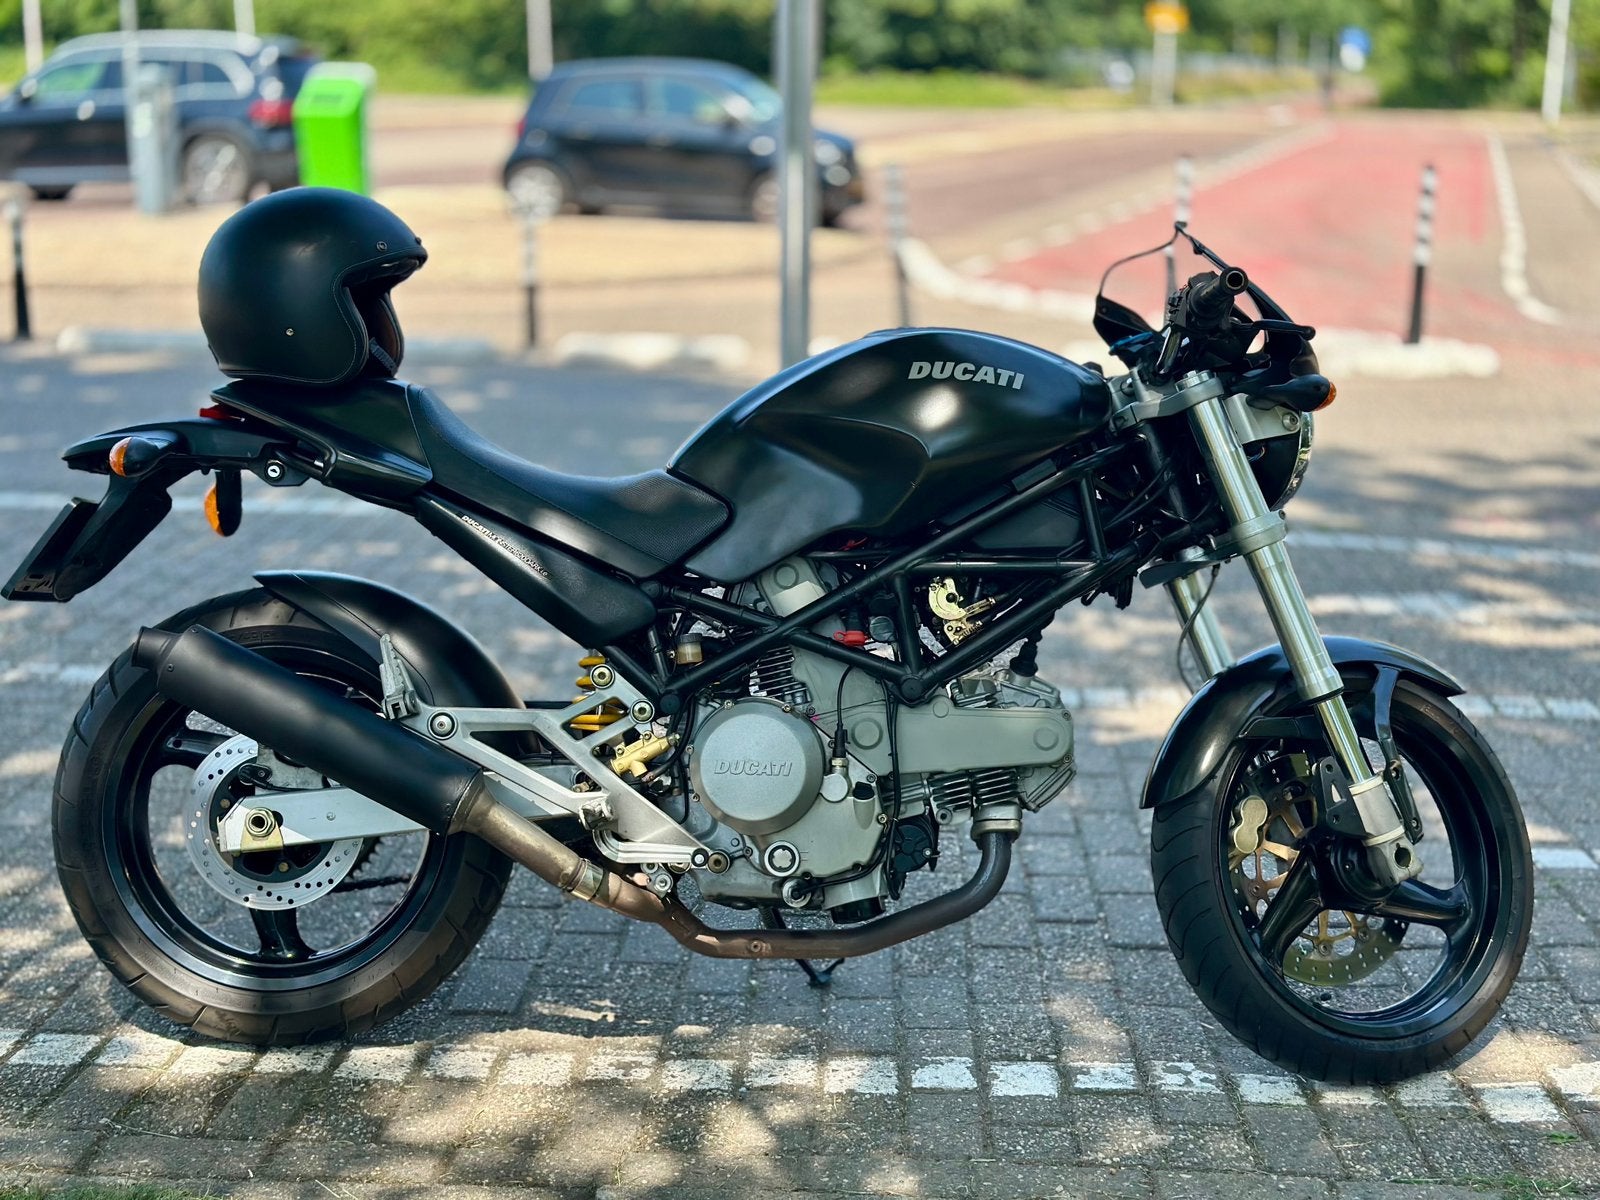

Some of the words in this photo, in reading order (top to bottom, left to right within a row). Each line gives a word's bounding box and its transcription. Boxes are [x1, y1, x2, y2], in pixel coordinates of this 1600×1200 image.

[908, 361, 1024, 390] DUCATI
[461, 515, 490, 536] DUCATI
[714, 760, 792, 777] DUCATI
